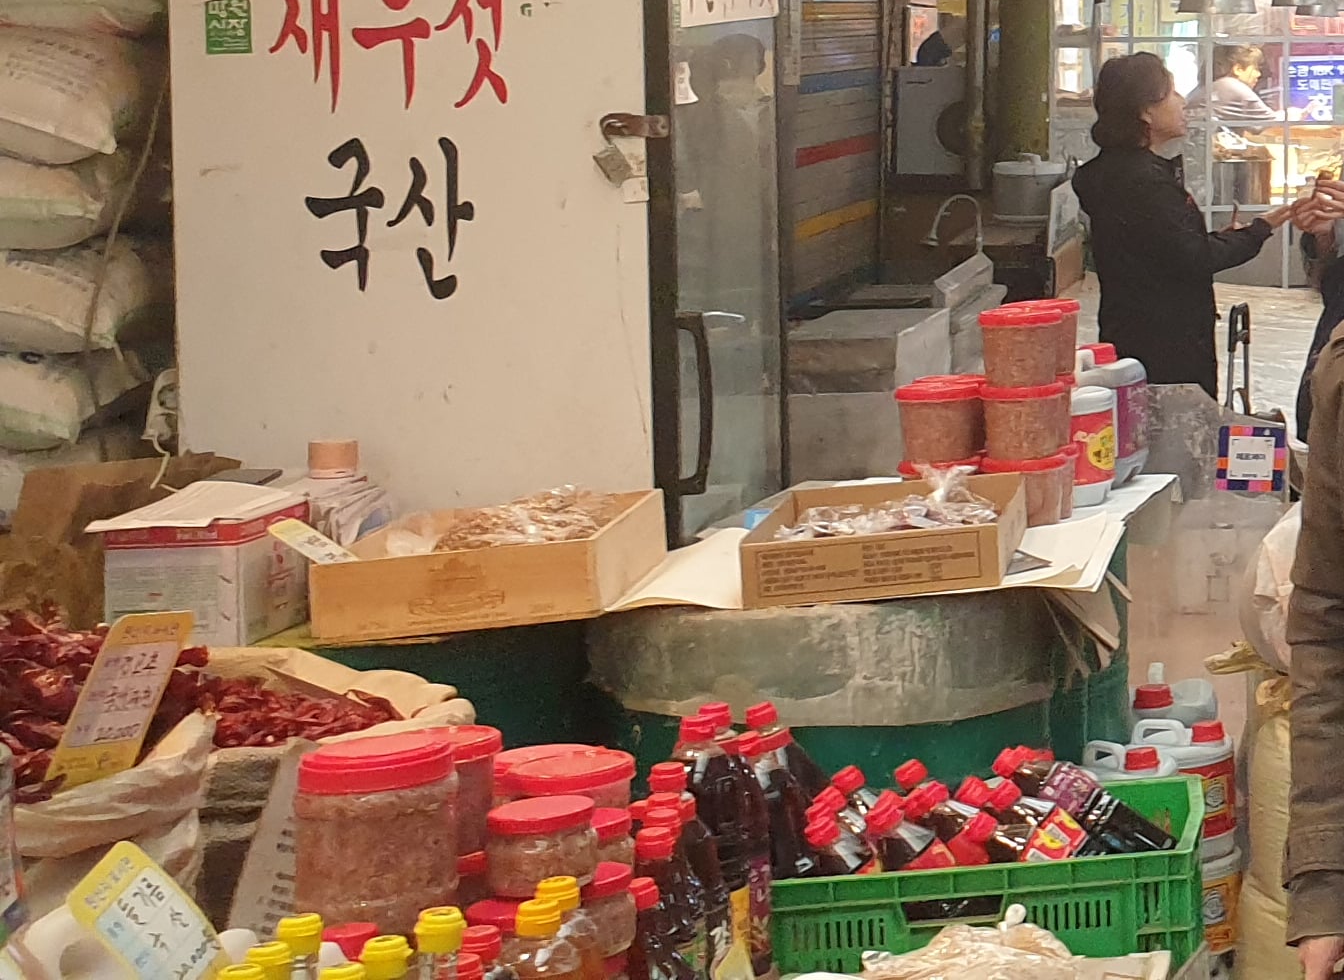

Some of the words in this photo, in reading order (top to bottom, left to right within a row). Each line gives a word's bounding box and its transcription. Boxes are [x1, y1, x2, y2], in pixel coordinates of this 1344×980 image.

[208, 0, 249, 17] 망원
[208, 18, 249, 37] 시장
[304, 136, 475, 300] 국산
